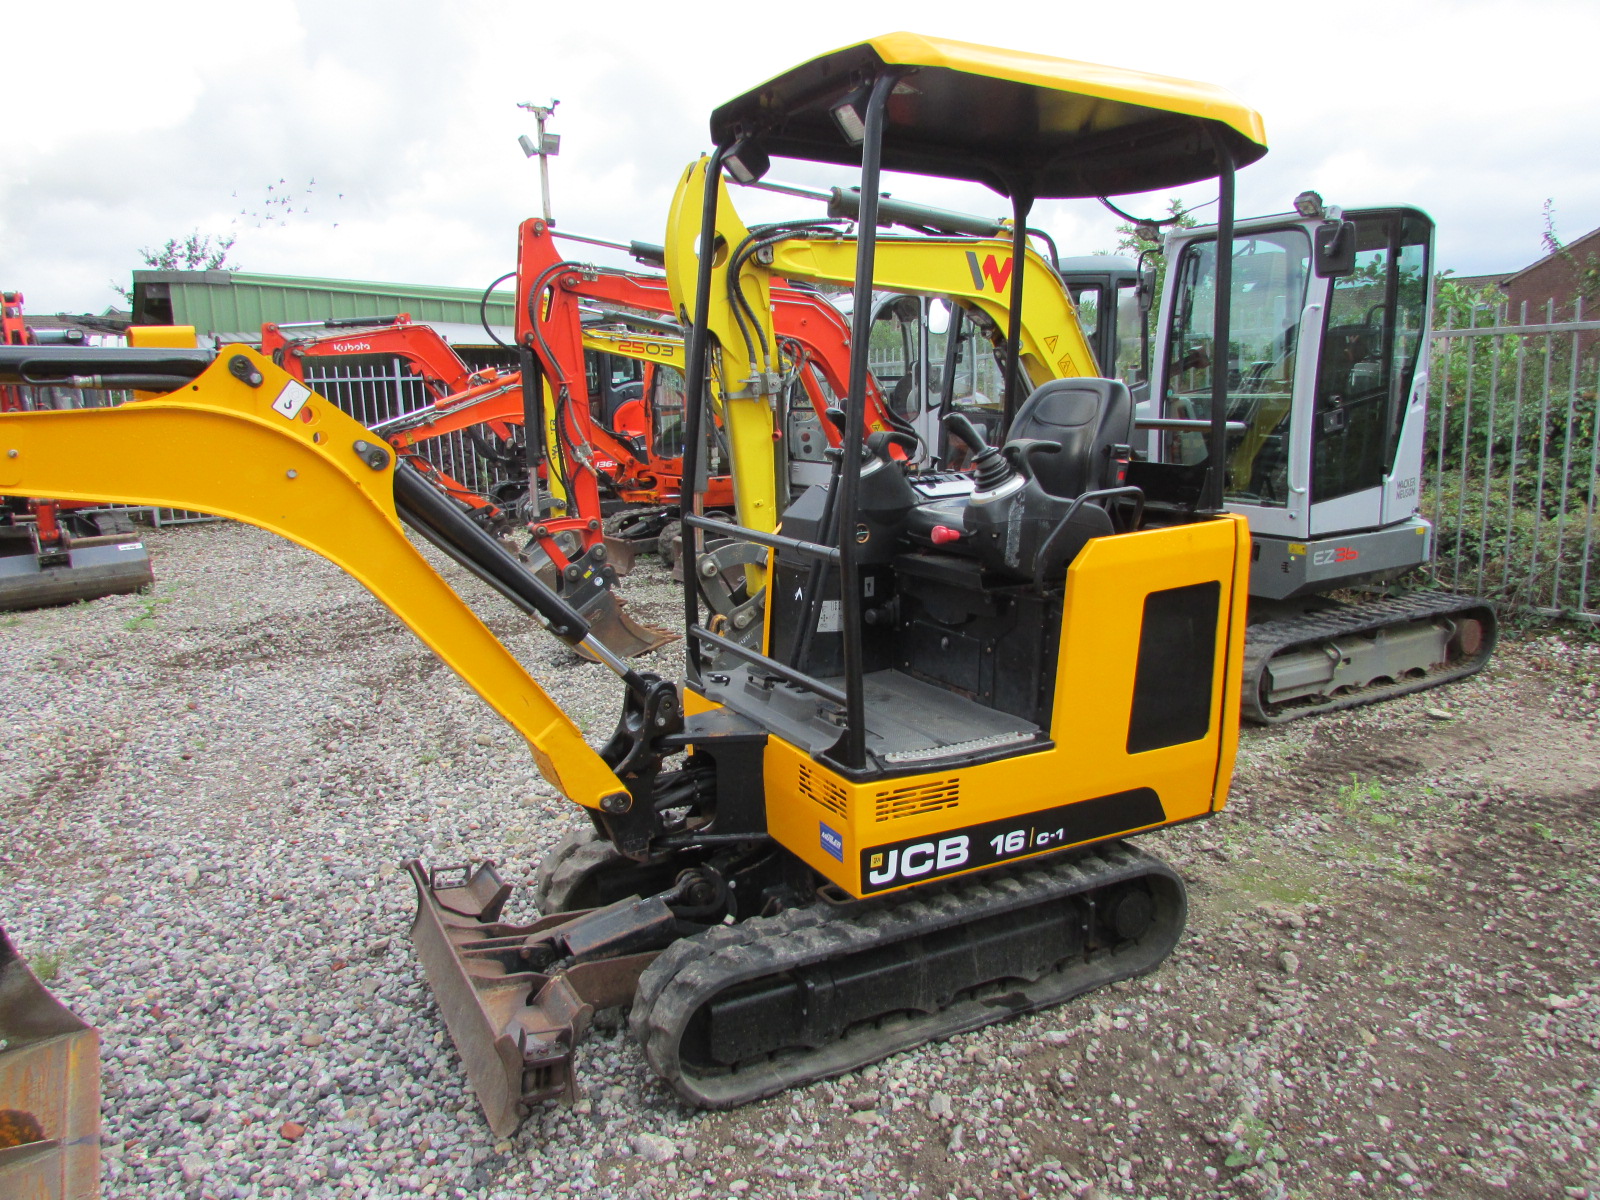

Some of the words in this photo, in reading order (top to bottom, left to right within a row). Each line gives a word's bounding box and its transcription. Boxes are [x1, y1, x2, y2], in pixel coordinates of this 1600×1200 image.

[333, 341, 371, 352] Kubota
[619, 340, 673, 357] 2503
[1313, 547, 1358, 566] EZ36
[869, 835, 970, 885] JCB
